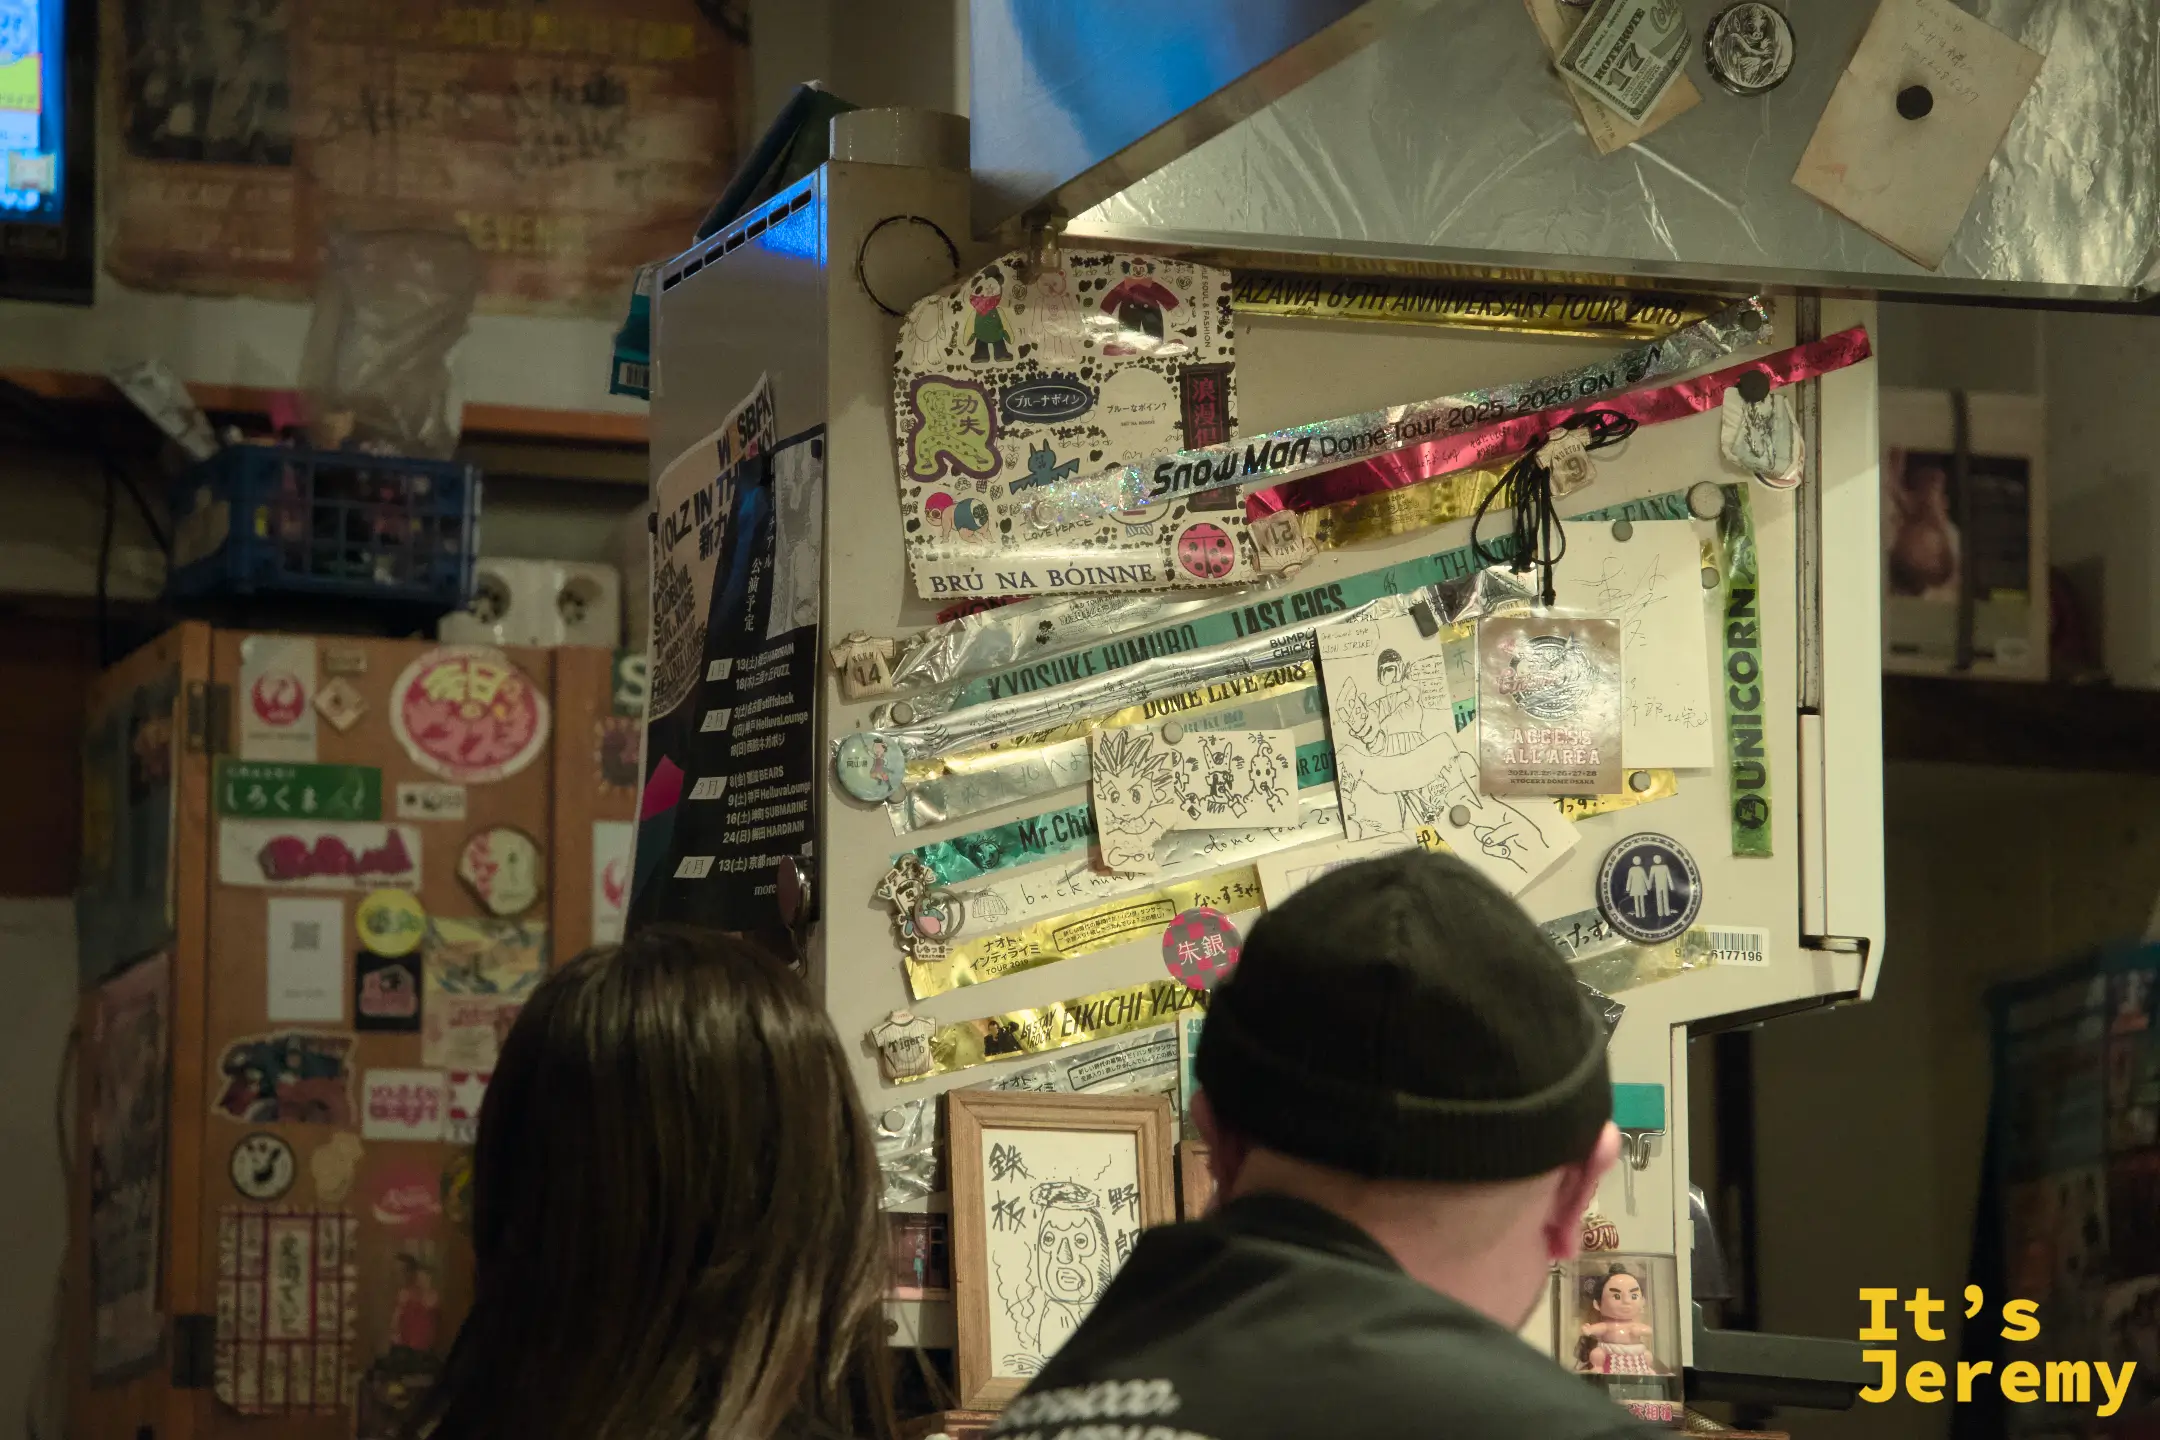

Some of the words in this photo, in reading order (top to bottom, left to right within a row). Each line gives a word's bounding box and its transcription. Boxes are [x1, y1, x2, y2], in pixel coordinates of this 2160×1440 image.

[1326, 280, 1391, 310] 69TH
[1392, 283, 1553, 319] ANNIVERSARY
[1559, 295, 1622, 324] TOUR
[1626, 301, 1686, 327] 2018
[1202, 310, 1211, 348] FASHION
[1014, 394, 1080, 408] ブルーナボイン
[1244, 437, 1310, 480] Man
[1319, 430, 1386, 459] Dome
[1393, 415, 1440, 444] Tour
[1447, 384, 1573, 430] 2025-2026
[1023, 529, 1053, 541] LOVE
[1054, 519, 1094, 537] PEACE
[928, 565, 984, 594] BRÚ
[995, 571, 1038, 591] NA
[1049, 560, 1158, 590] BÓINNE
[1233, 599, 1289, 639] LAST
[987, 651, 1098, 701] KYOSUKE
[1143, 690, 1201, 720] DOME
[1207, 675, 1259, 704] LIVE
[1726, 588, 1770, 791] UNICORN
[1512, 728, 1593, 746] ACCESS
[1504, 749, 1543, 765] ALL
[1548, 749, 1602, 766] AREA
[1510, 778, 1546, 786] KYOCERA
[725, 810, 751, 827] 16(土)
[722, 828, 751, 845] 24(日)
[1203, 831, 1257, 854] dome
[718, 857, 747, 873] 13(土)
[753, 884, 776, 896] more
[969, 942, 1042, 972] インティライミ
[1177, 933, 1228, 965] 朱銀
[985, 964, 1009, 976] TOUR
[1010, 958, 1030, 971] 2019
[1033, 1008, 1057, 1035] STAY
[1060, 989, 1145, 1038] EIKICHI
[887, 1033, 926, 1057] Tigers
[1029, 1025, 1054, 1049] ROCK
